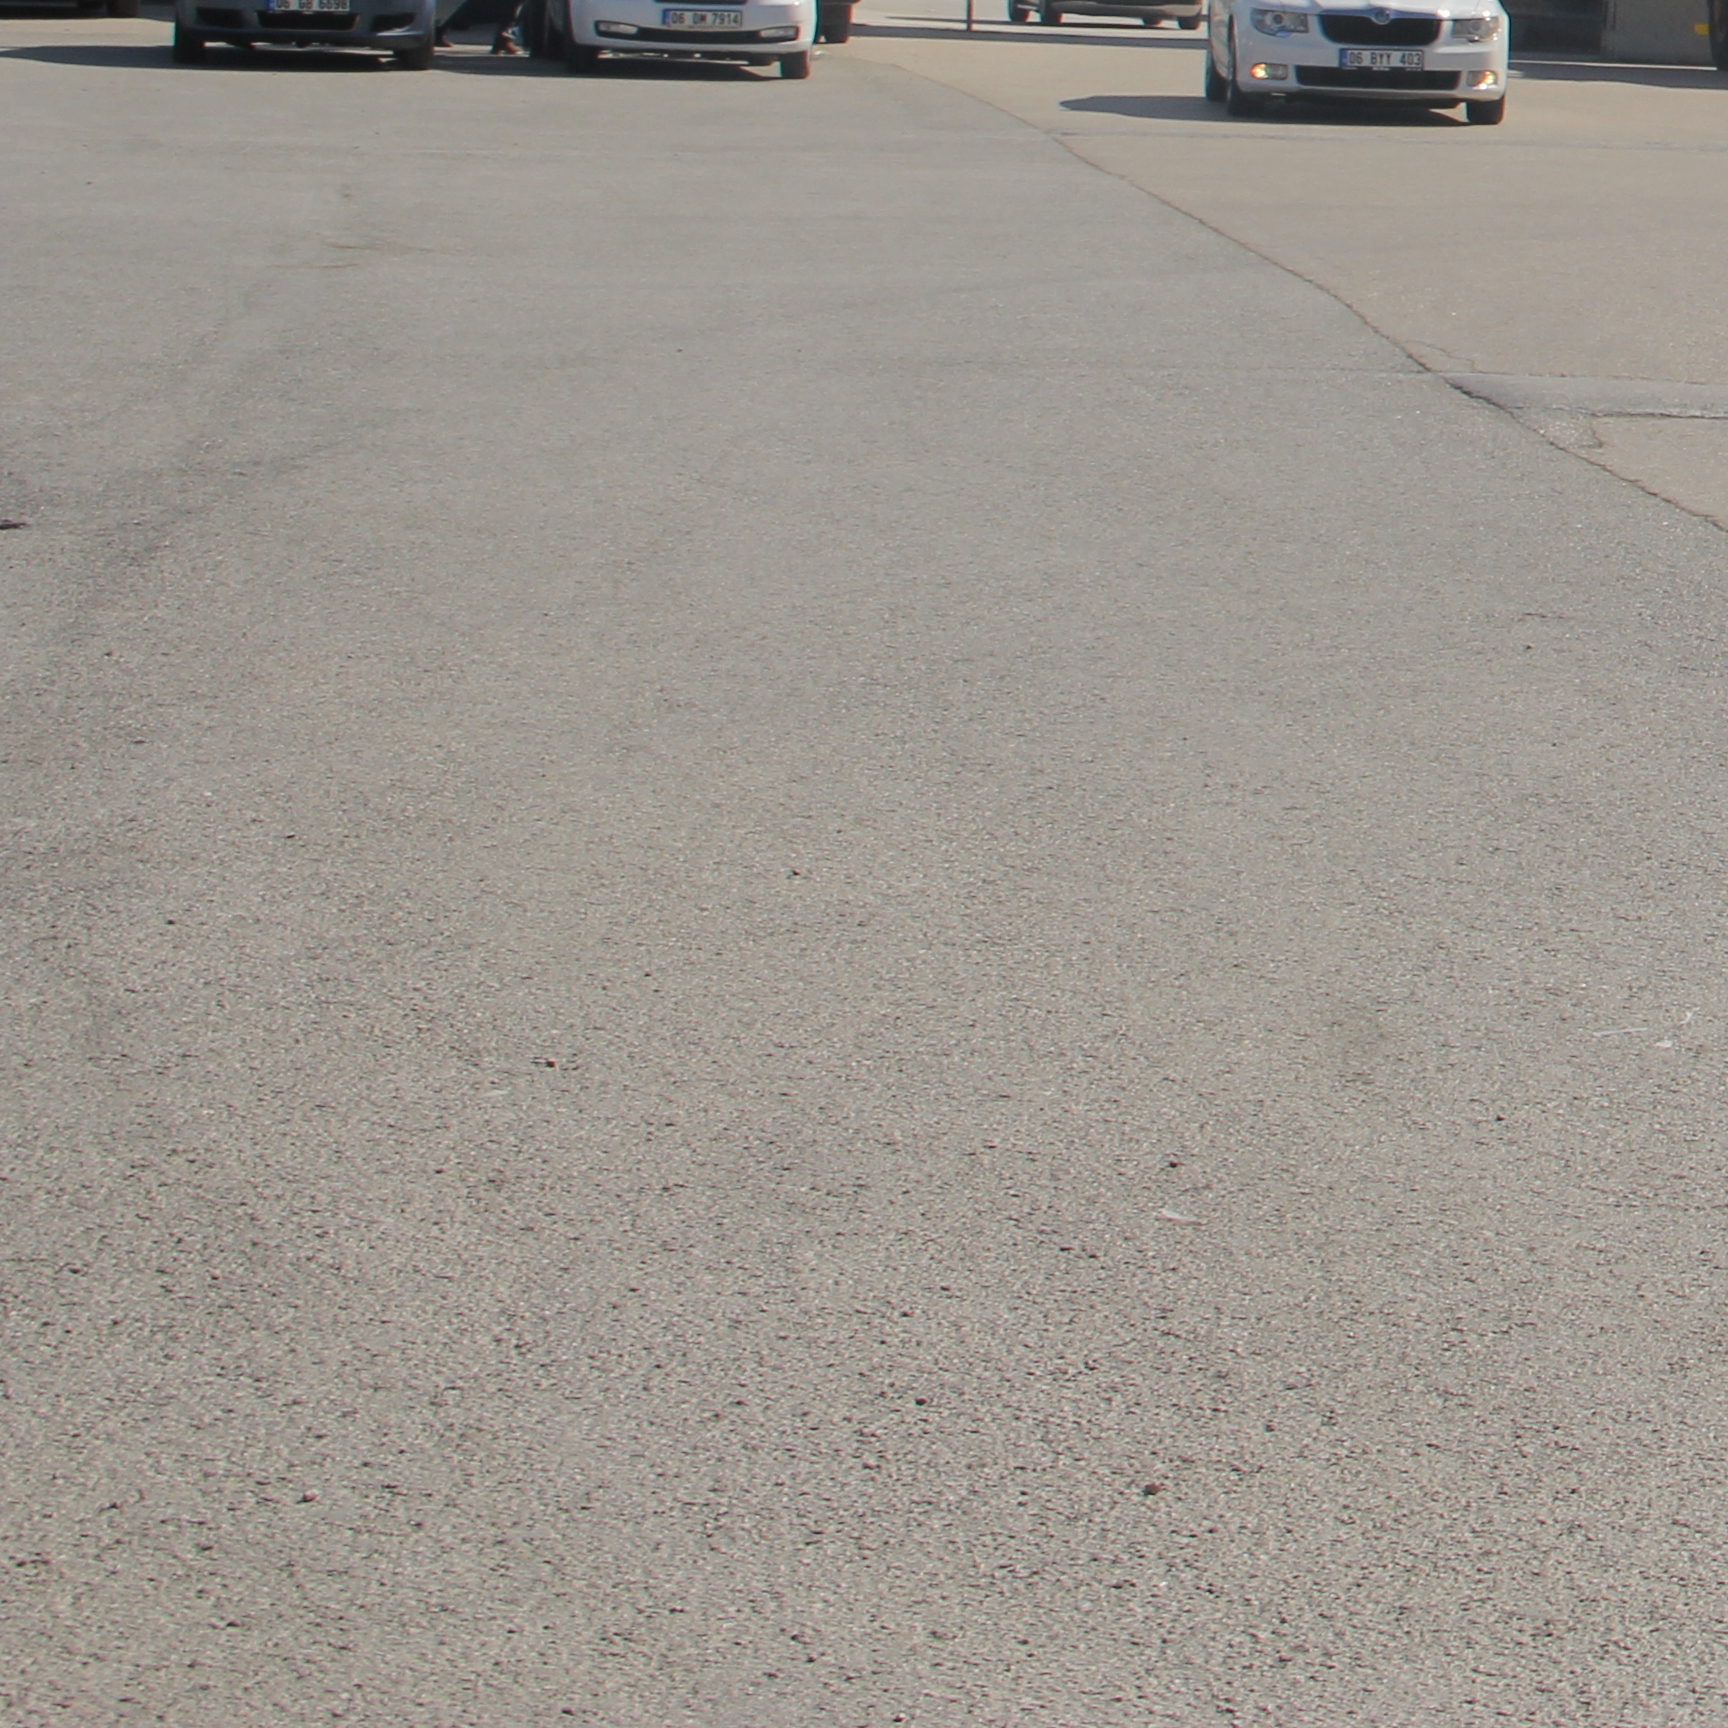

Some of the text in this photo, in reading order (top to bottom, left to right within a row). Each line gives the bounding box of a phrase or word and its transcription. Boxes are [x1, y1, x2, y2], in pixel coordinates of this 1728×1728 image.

[672, 12, 686, 24] 06
[1349, 52, 1363, 64] 06
[1399, 53, 1421, 66] 403
